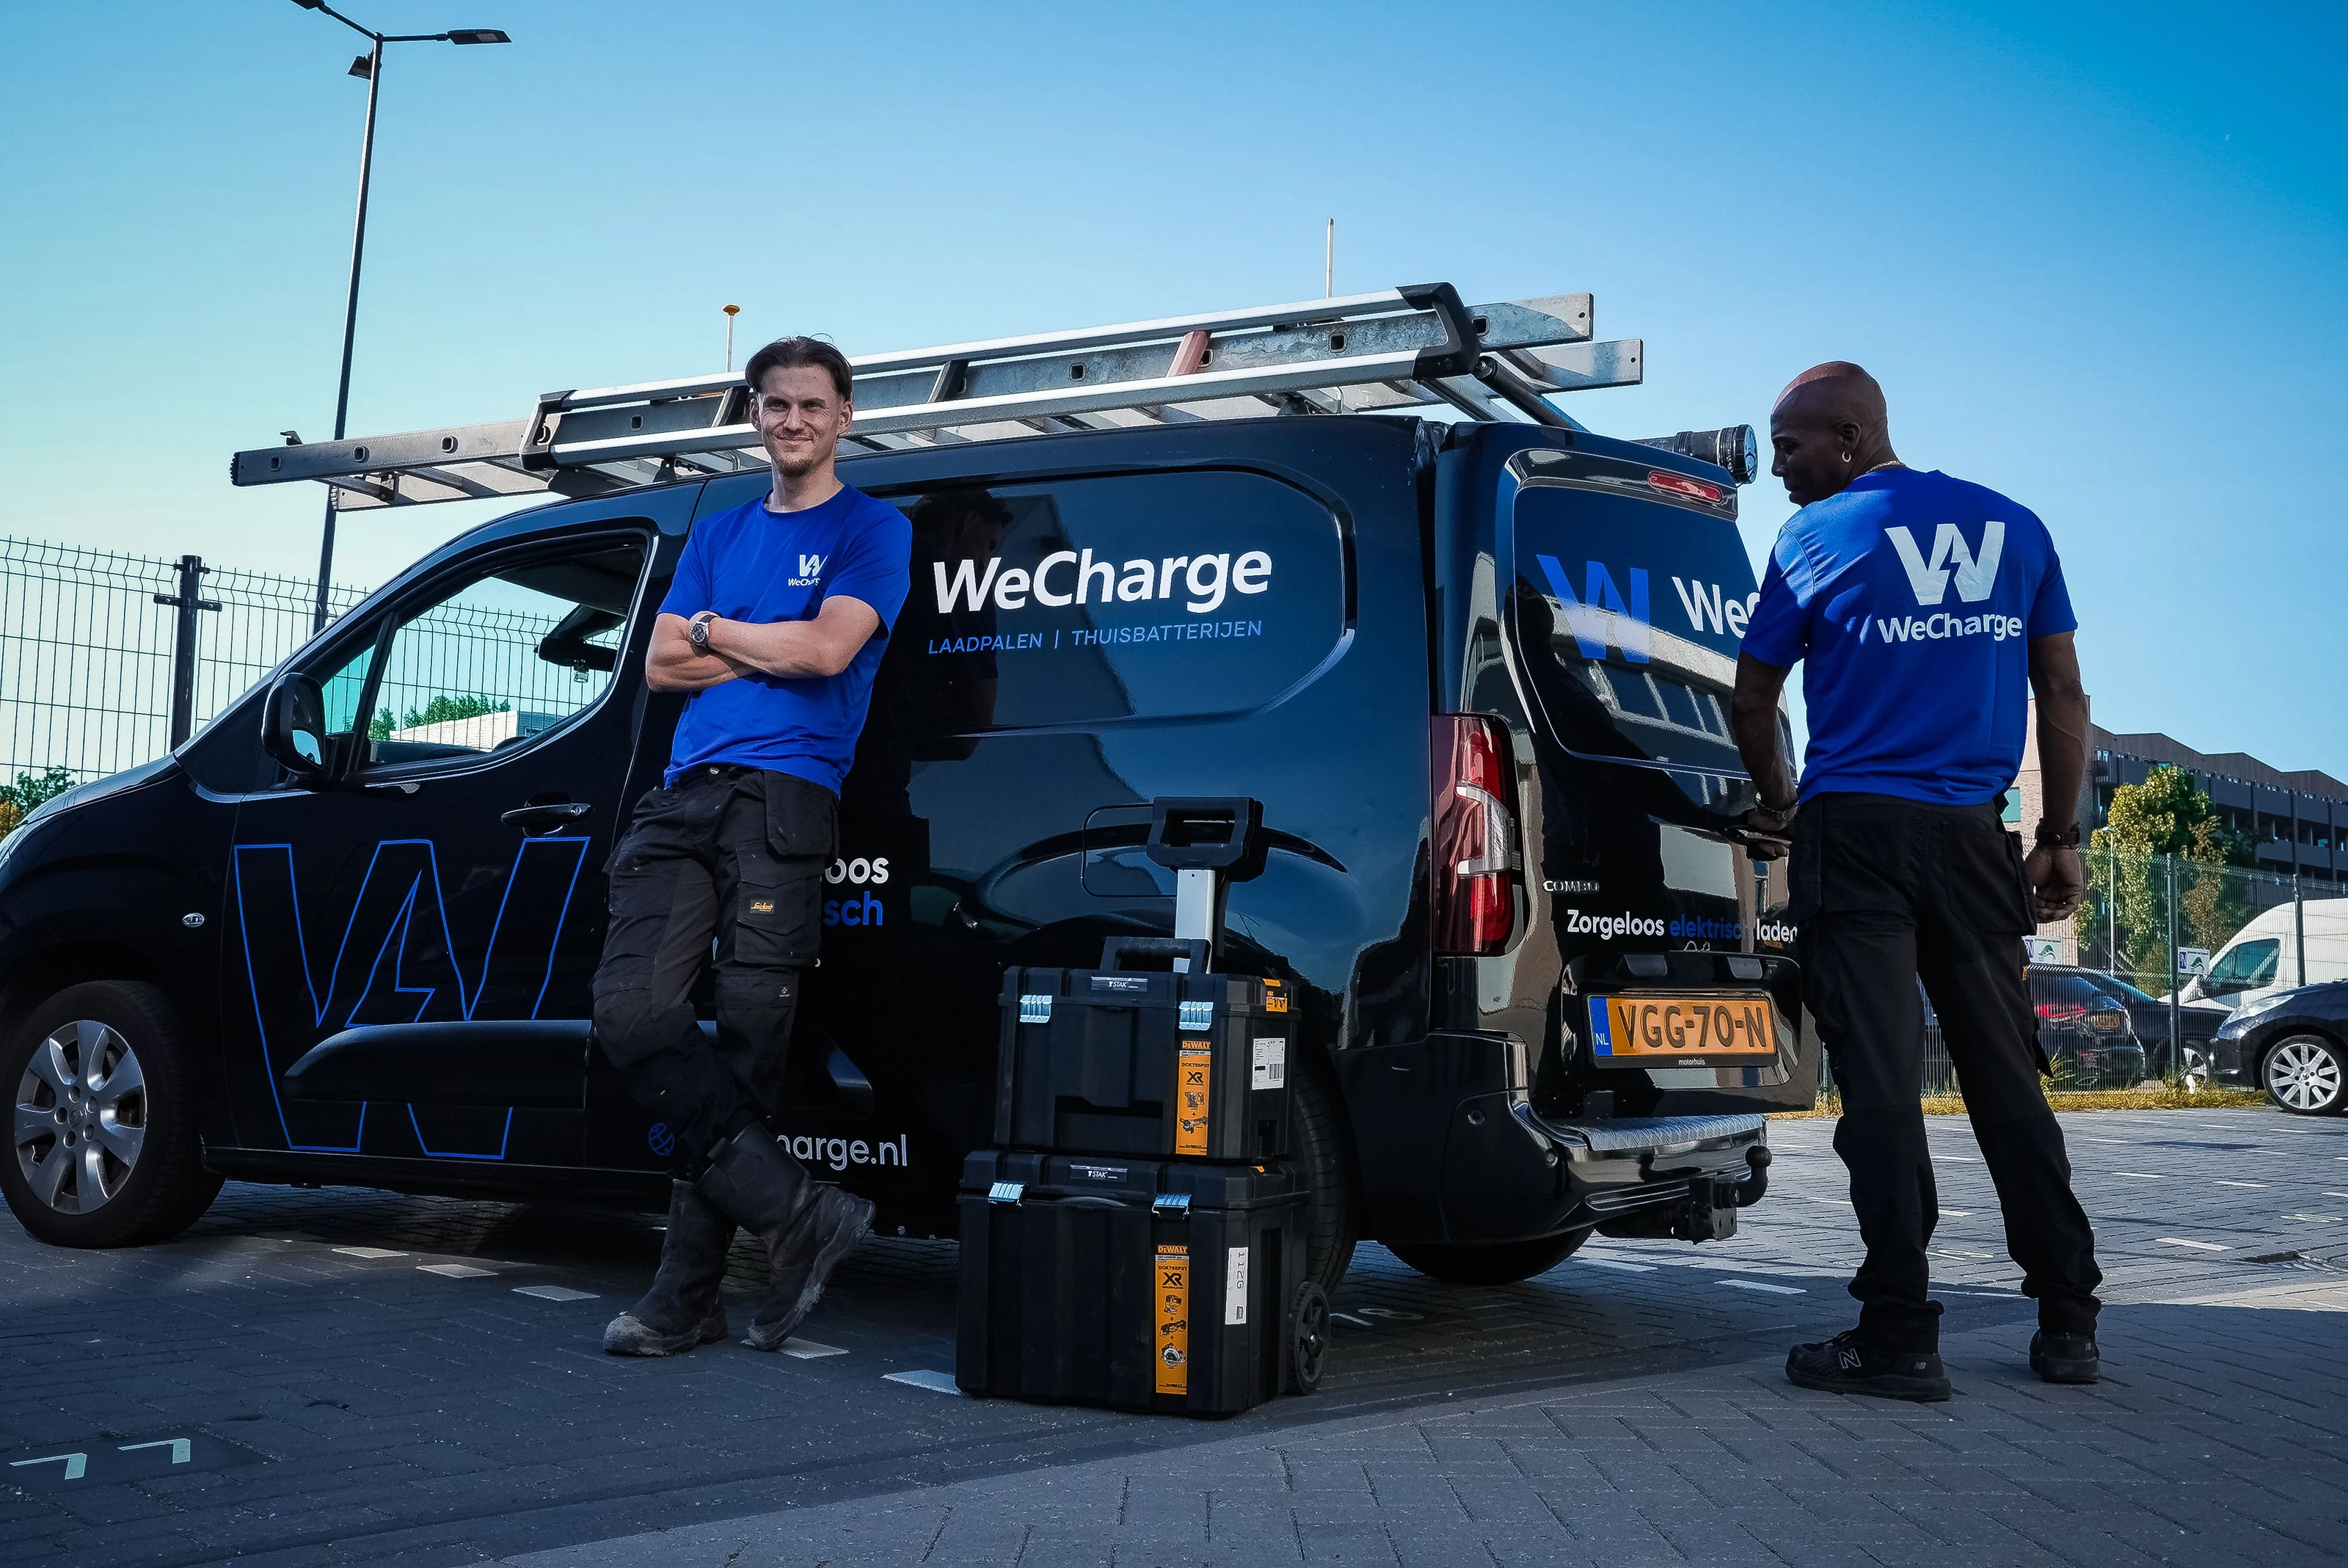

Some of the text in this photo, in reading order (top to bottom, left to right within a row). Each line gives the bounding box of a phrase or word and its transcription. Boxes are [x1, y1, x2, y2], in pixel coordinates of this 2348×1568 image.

[933, 548, 1272, 614] WeCharge
[928, 632, 1043, 654] LAADPALEN
[1071, 620, 1262, 646] THUISBATTERIJEN
[1877, 613, 2023, 643] WeCharge
[825, 857, 889, 884] oos
[1542, 880, 1600, 892] COMBO
[823, 891, 883, 926] sch
[1567, 909, 1665, 940] Zorgeloos
[1595, 1032, 1609, 1046] NL
[1617, 1004, 1767, 1049] VGG-70-N
[1678, 1057, 1706, 1065] motorhuis
[1186, 1071, 1204, 1083] XR
[776, 1133, 908, 1171] arge.nl
[1162, 1272, 1184, 1286] XR
